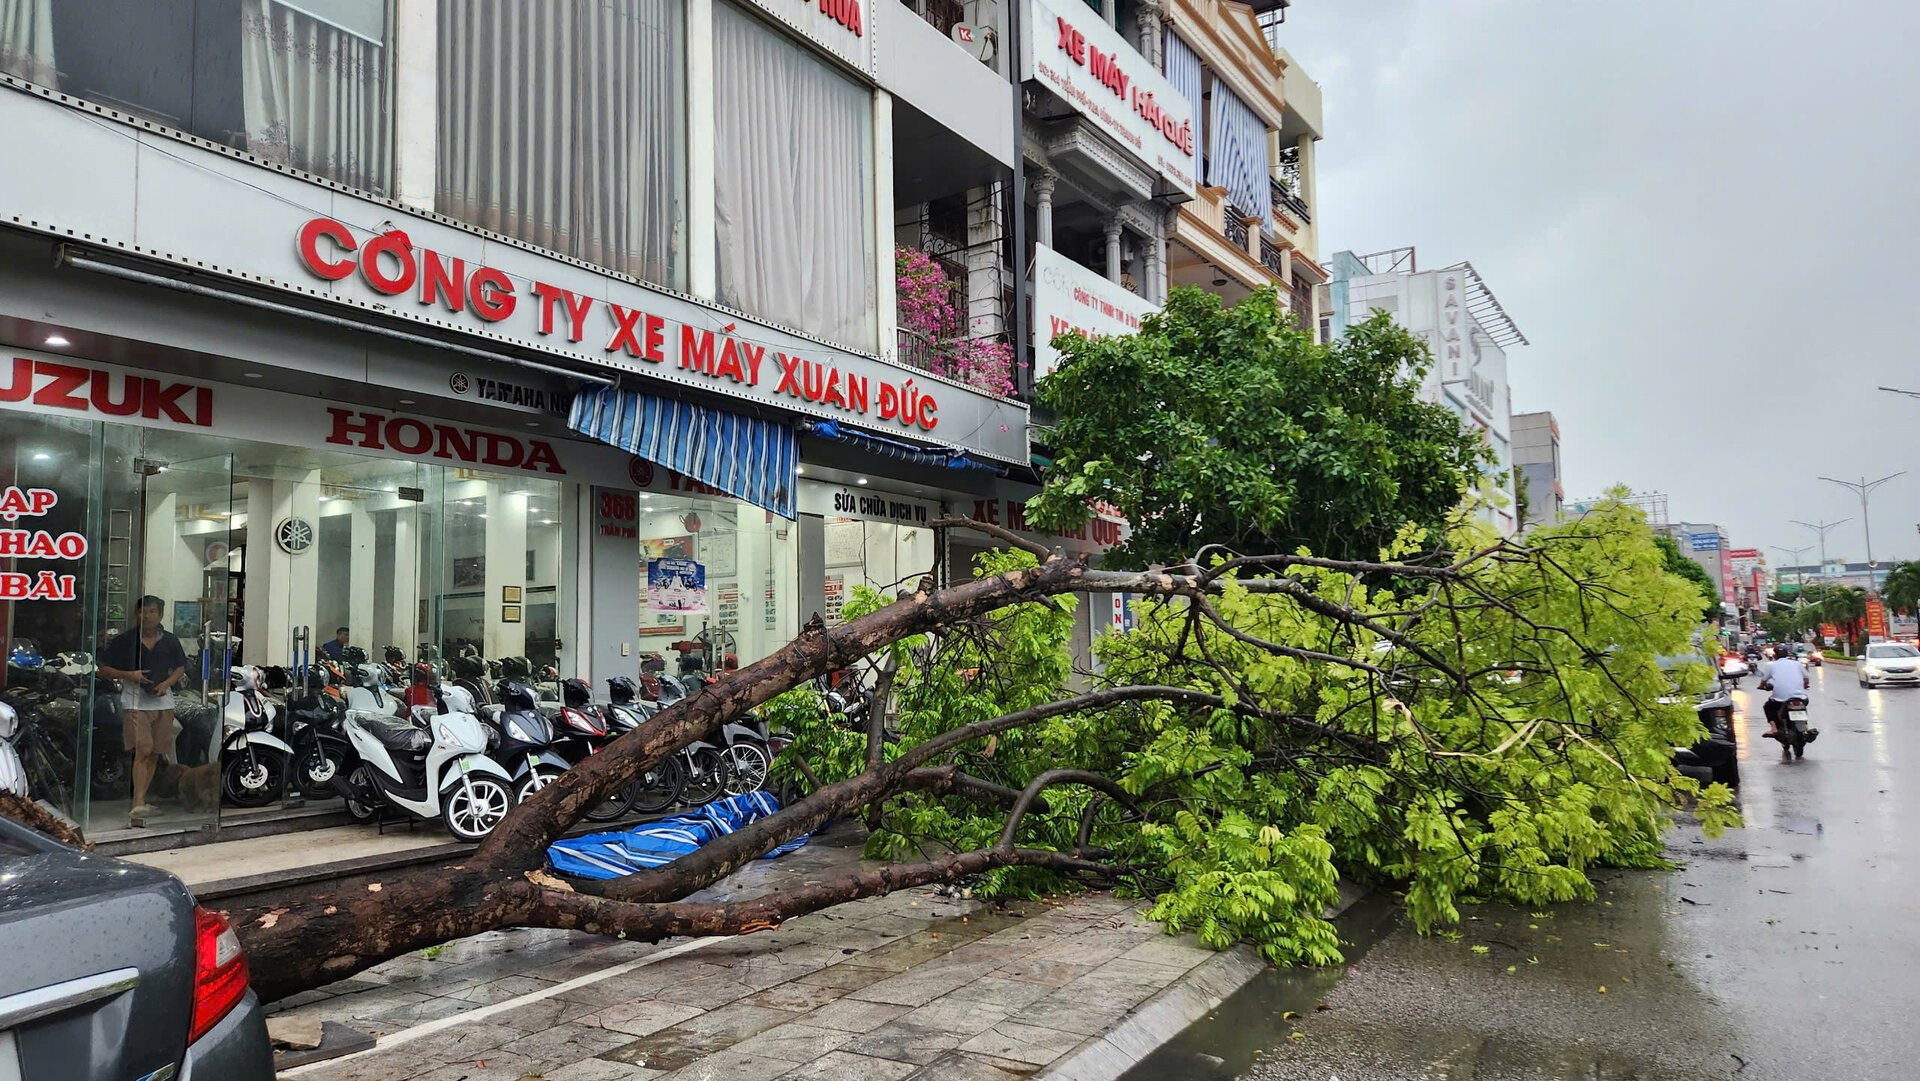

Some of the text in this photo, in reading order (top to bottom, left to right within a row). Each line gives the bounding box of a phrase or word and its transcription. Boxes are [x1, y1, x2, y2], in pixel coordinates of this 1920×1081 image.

[1057, 16, 1085, 67] XE
[1089, 45, 1130, 101] MÁY
[295, 217, 517, 323] CÔNG
[530, 280, 594, 343] TY
[605, 302, 665, 364] XE
[677, 321, 766, 387] MÁY
[874, 376, 940, 432] ĐỨC
[1444, 276, 1461, 376] SAVANI
[325, 407, 567, 475] HONDA
[600, 489, 636, 522] 368
[834, 487, 927, 527] SỬA CHỮA DỊCH VỤ
[0, 571, 74, 599] BÃI
